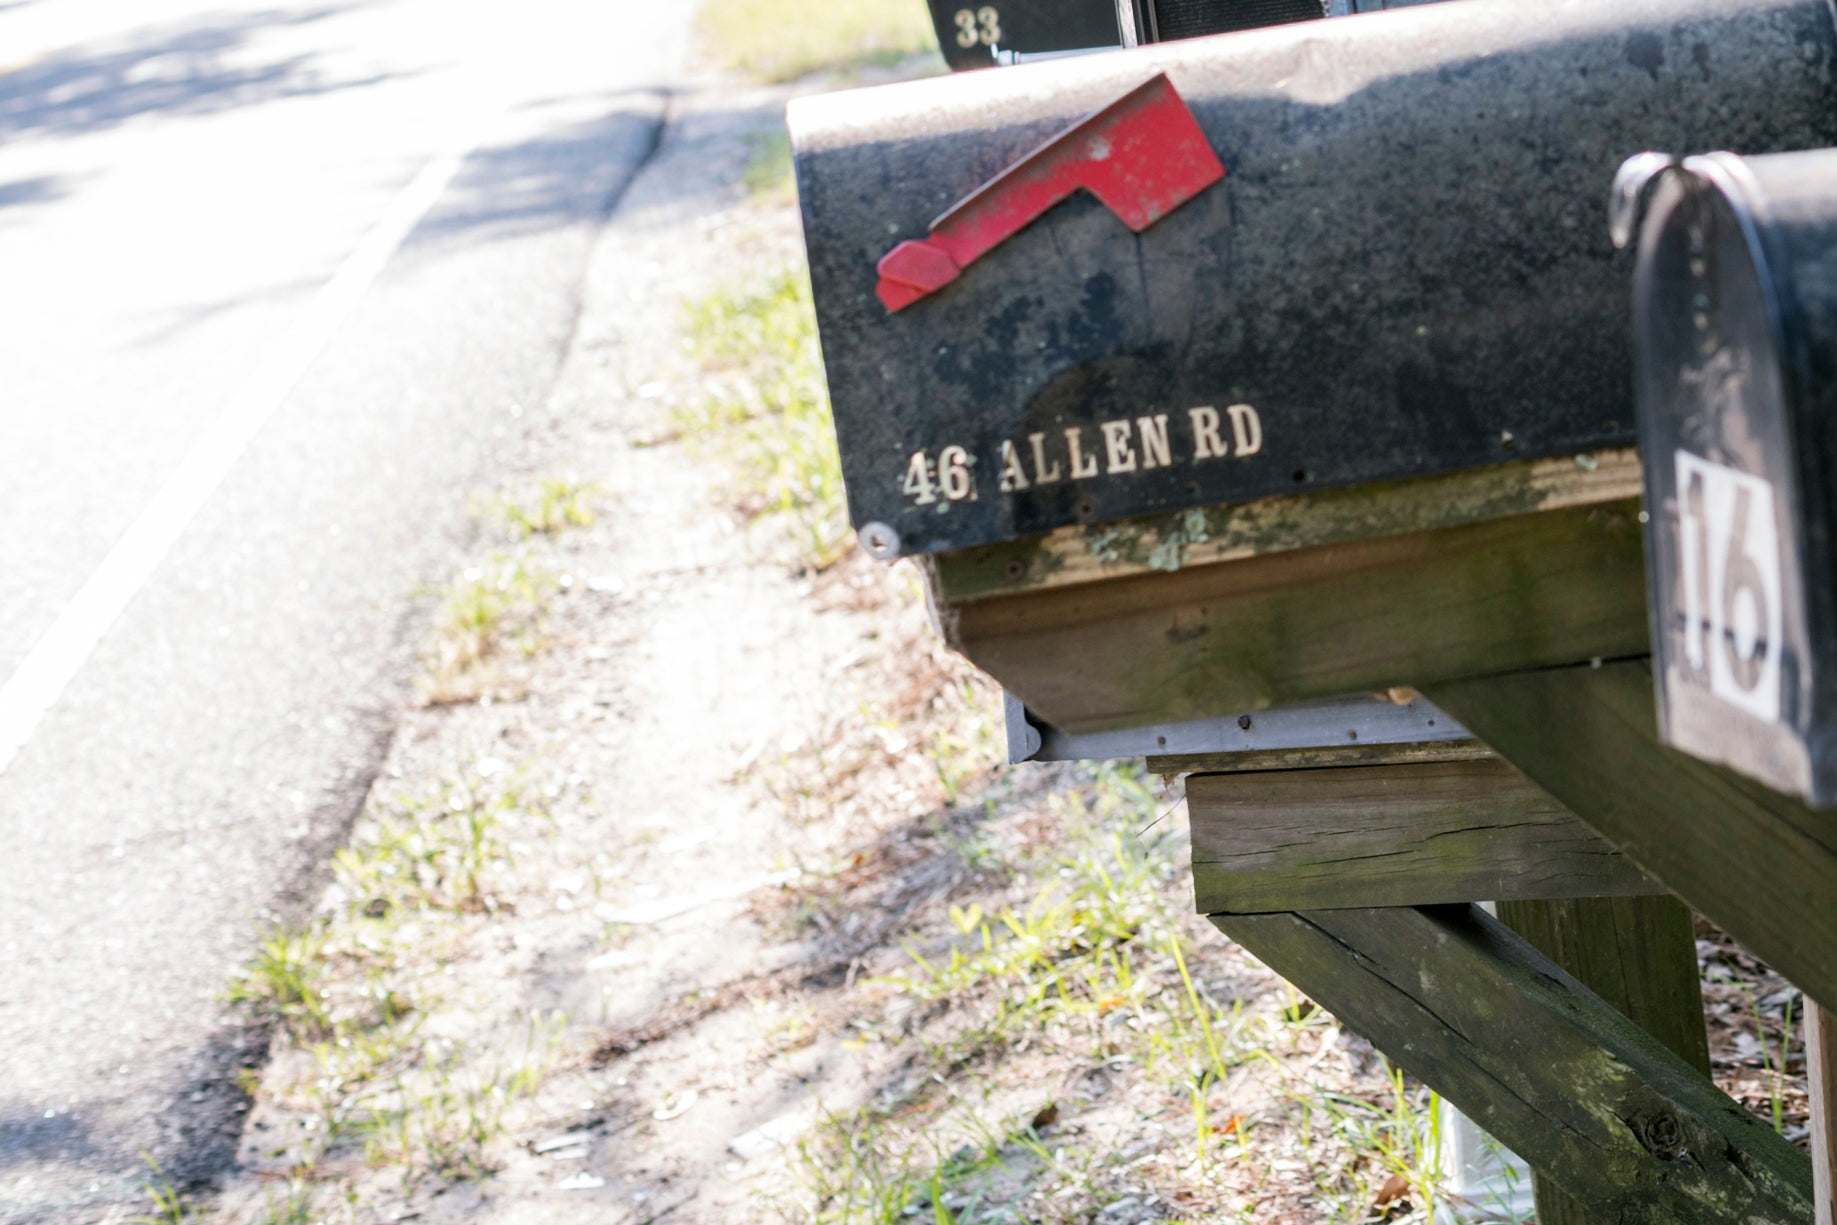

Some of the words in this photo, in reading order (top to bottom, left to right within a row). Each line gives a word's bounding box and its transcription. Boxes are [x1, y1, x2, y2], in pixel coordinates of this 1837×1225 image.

[954, 6, 1001, 48] 33
[902, 445, 973, 505] 46
[999, 414, 1172, 493] ALLEN
[1188, 403, 1263, 469] RD
[1676, 470, 1769, 694] 16
